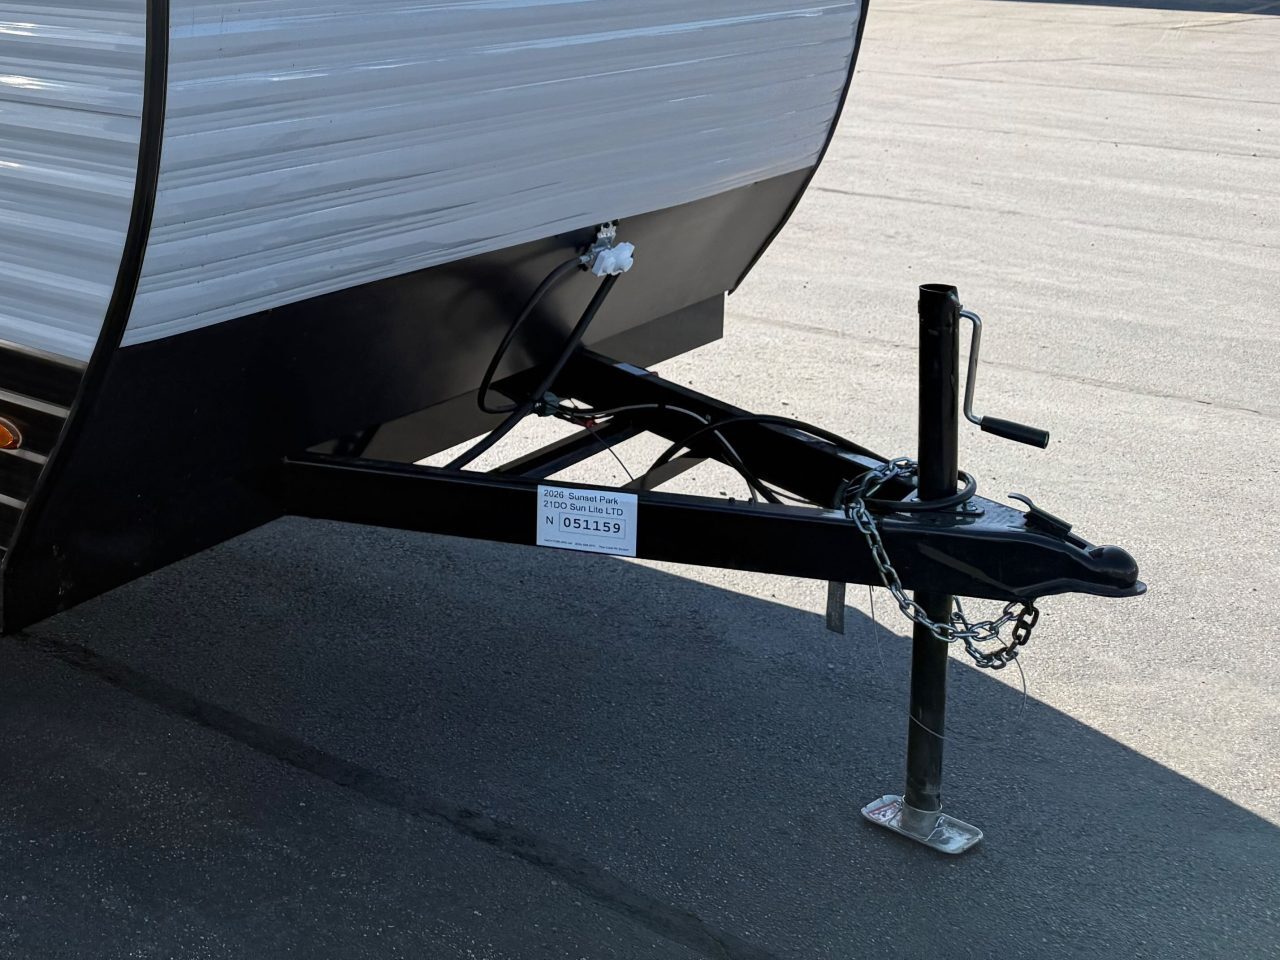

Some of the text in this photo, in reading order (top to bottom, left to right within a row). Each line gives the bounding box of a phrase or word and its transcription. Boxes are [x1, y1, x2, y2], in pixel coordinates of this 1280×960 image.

[543, 489, 619, 505] 2026 Sunset Park
[569, 503, 586, 512] Sun
[588, 504, 604, 514] Lite
[605, 508, 623, 516] LTD
[545, 515, 621, 534] N 051159
